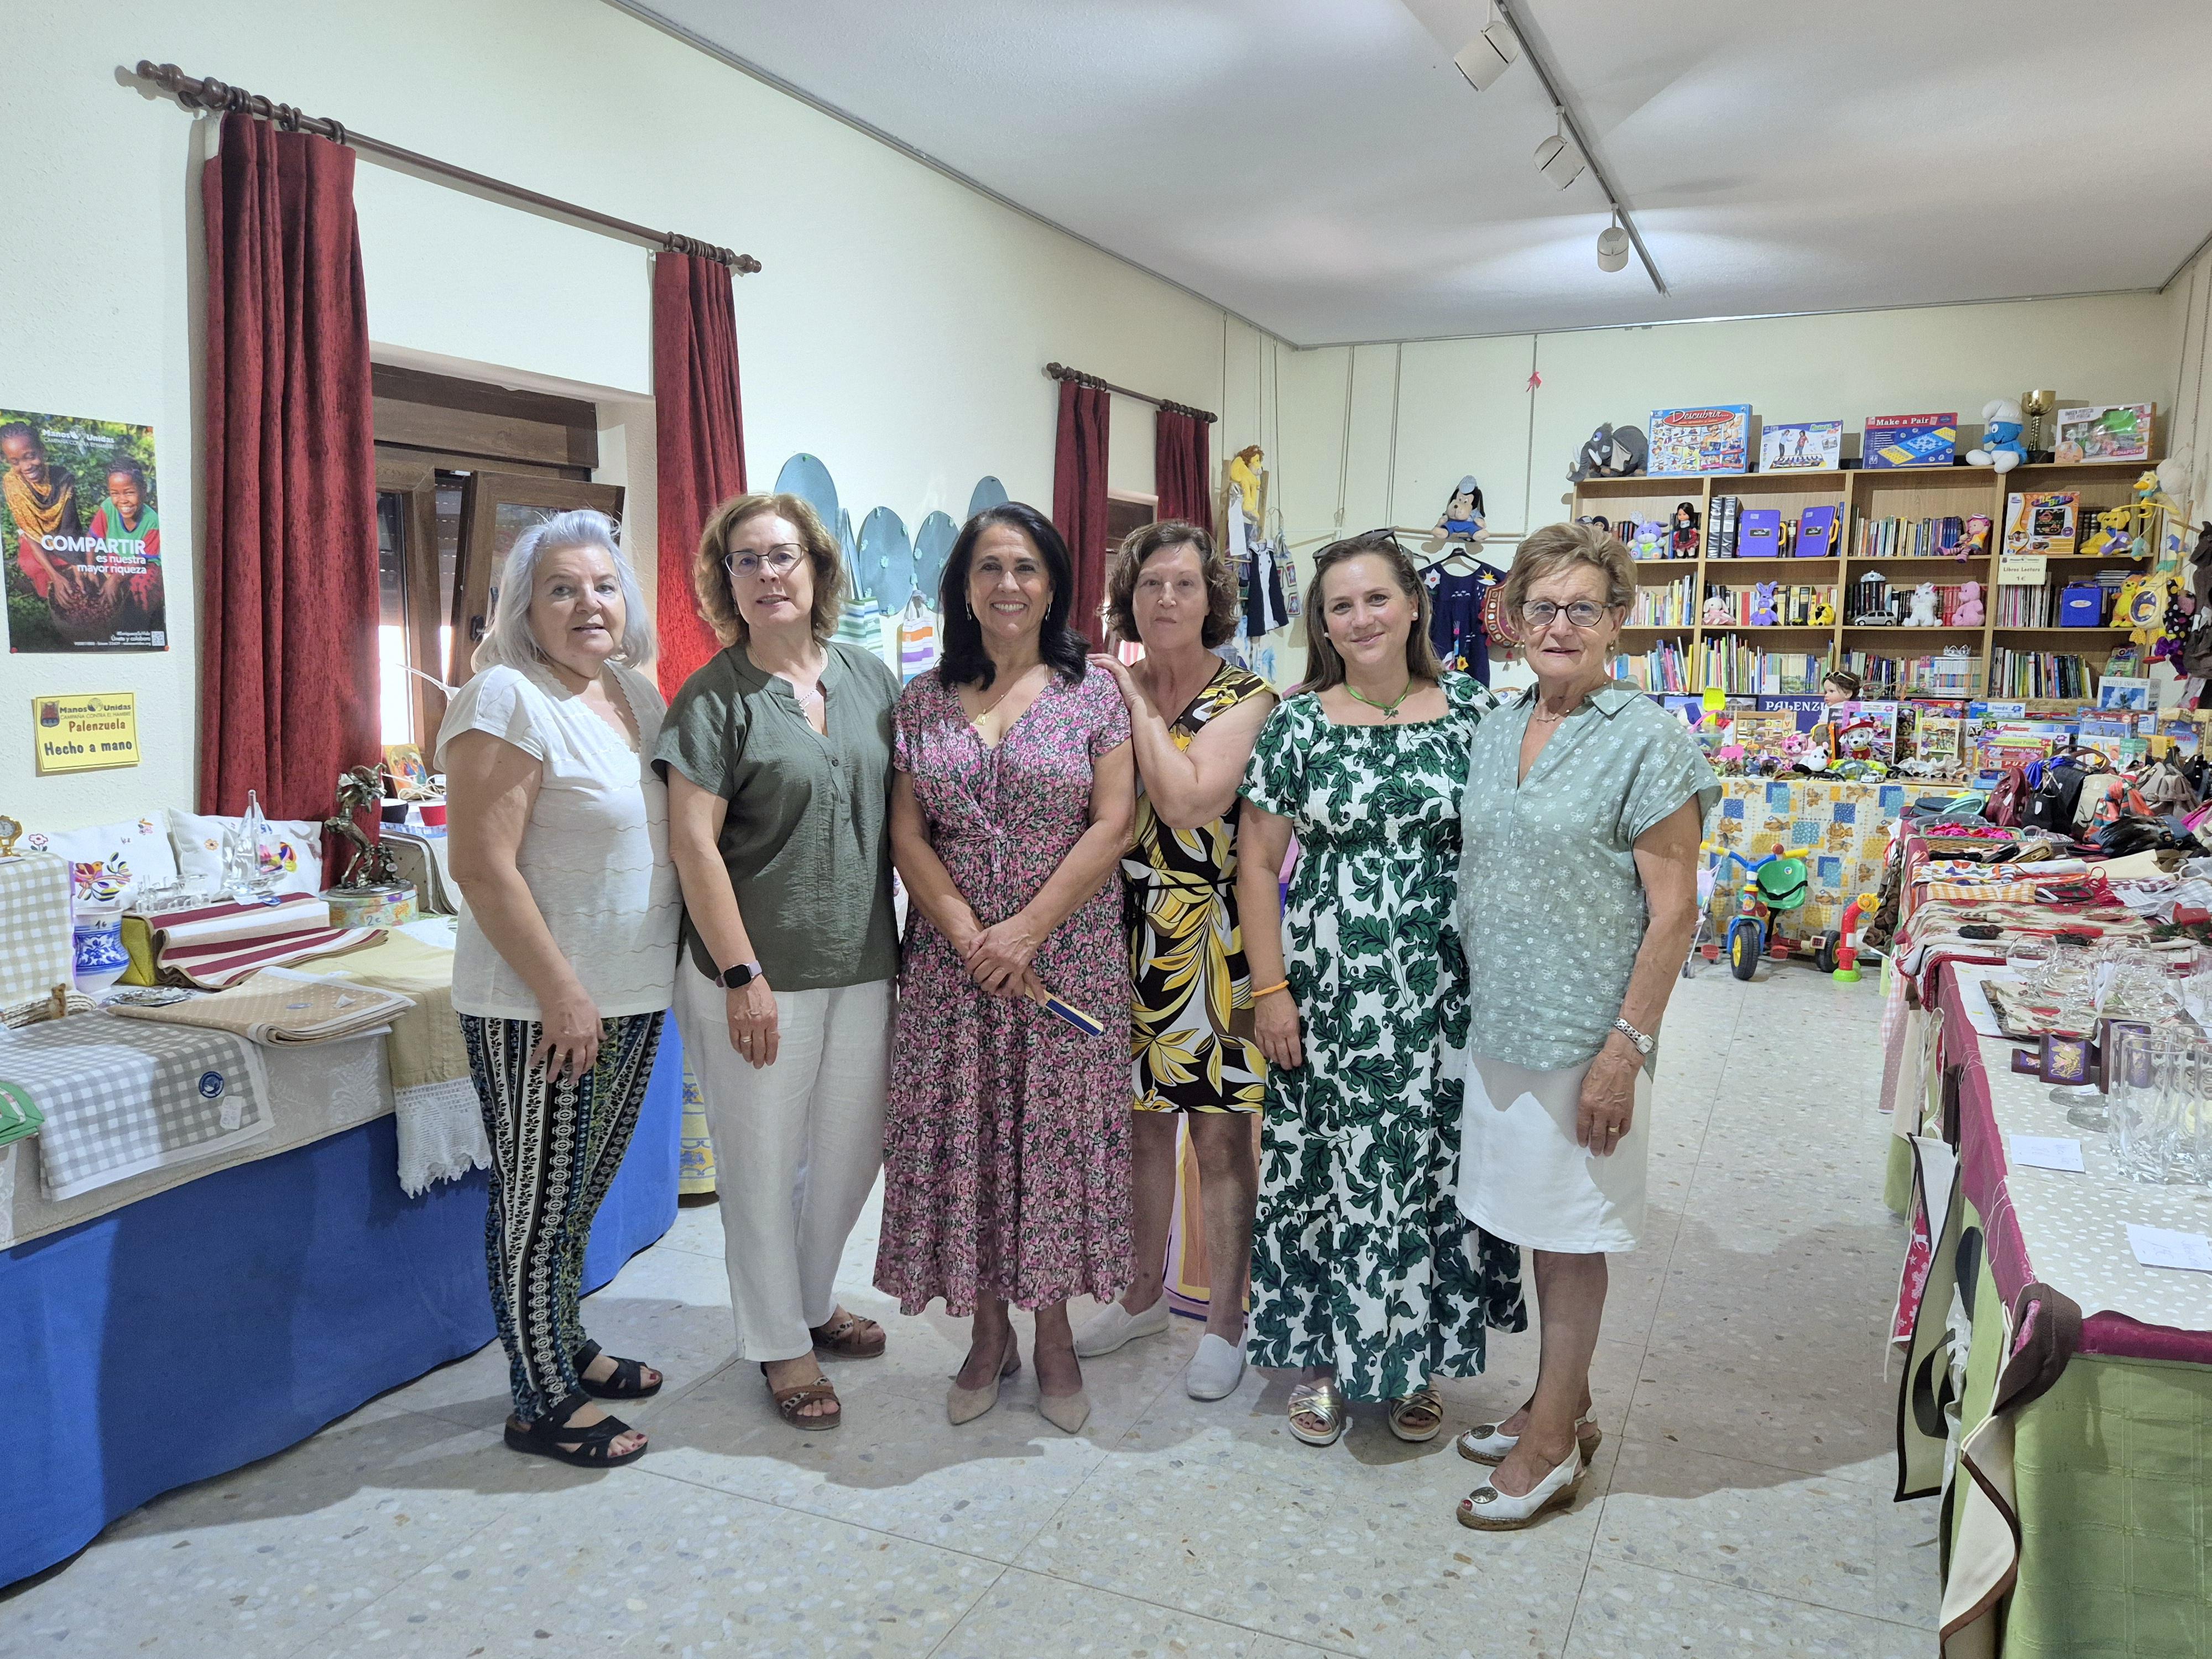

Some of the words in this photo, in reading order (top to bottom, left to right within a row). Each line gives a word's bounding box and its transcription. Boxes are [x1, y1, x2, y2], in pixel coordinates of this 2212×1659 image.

[41, 429, 71, 439] Manos
[86, 434, 115, 443] Unidas
[41, 535, 147, 555] COMPARTIR
[109, 555, 146, 564] nuestra
[77, 564, 109, 575] mayor
[110, 563, 147, 576] riqueza
[69, 718, 126, 733] Palenzuela
[44, 740, 84, 756] Hecho
[89, 744, 96, 753] a
[101, 740, 132, 752] mano
